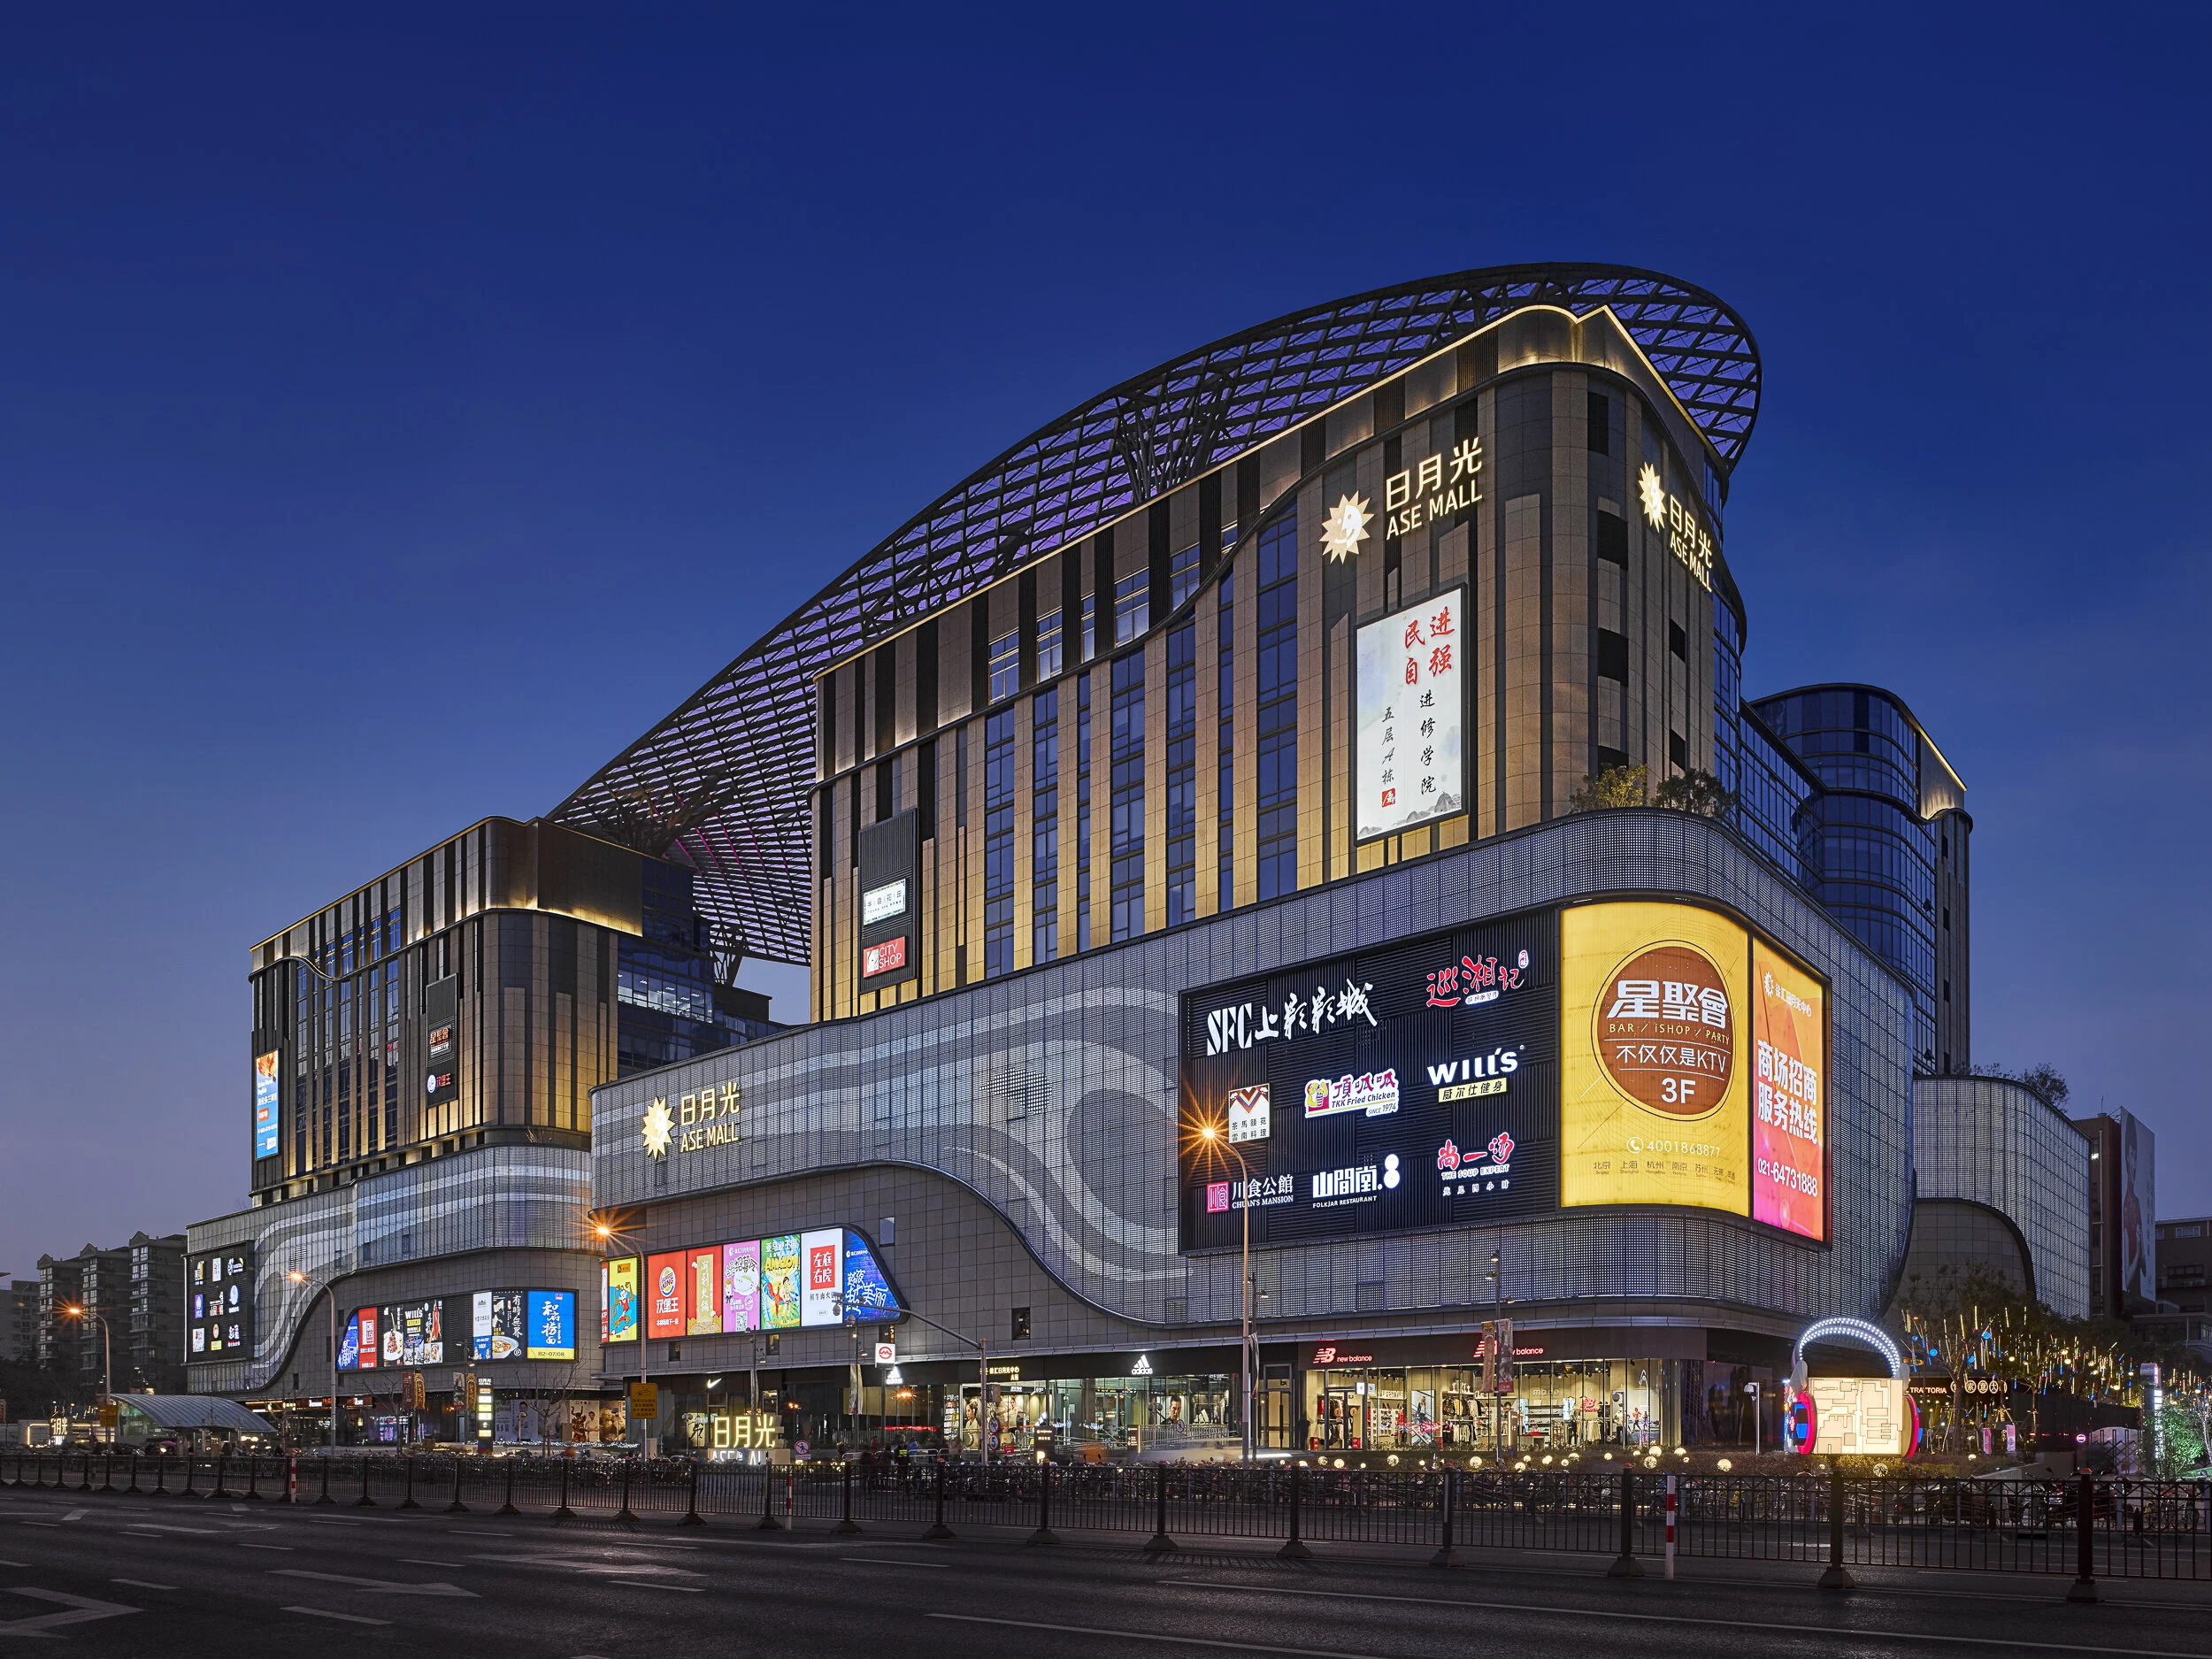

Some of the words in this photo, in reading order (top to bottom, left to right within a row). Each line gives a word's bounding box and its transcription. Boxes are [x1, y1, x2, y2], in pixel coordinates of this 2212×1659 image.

[1386, 436, 1482, 511] 日月光
[1386, 510, 1422, 541] ASE
[1429, 480, 1482, 522] MALL
[1670, 494, 1712, 569] 日月光
[1670, 532, 1688, 565] ASE
[1689, 551, 1712, 592] MALL
[1419, 689, 1437, 795] 进修学院
[879, 942, 899, 958] CITY
[879, 952, 902, 969] SHOP
[1606, 979, 1728, 1030] 星聚會
[1207, 1002, 1252, 1056] SFC
[1609, 1023, 1635, 1033] BAR
[1705, 1030, 1730, 1046] PARTY
[1616, 1043, 1726, 1074] 不仅仅是KTV
[1757, 1040, 1817, 1106] 商场招商
[1332, 1099, 1346, 1109] TKK
[1347, 1095, 1366, 1106] Fried
[1367, 1092, 1395, 1102] Chicken
[1442, 1080, 1503, 1101] 威尔仕健身
[1661, 1077, 1696, 1104] 3F
[680, 1081, 740, 1126] 日月光
[1368, 1107, 1381, 1116] SINCE
[1382, 1102, 1396, 1112] 1974
[1757, 1078, 1818, 1145] 服务热线
[680, 1128, 704, 1153] ASE
[706, 1121, 739, 1146] MALL
[1232, 1128, 1267, 1142] 雲南料理
[1647, 1140, 1721, 1158] 4001868877
[1441, 1171, 1457, 1180] THE
[1458, 1168, 1479, 1179] SOUP
[1479, 1164, 1509, 1175] EXPERT
[1593, 1161, 1611, 1170] 北京
[1620, 1160, 1638, 1169] 上海
[1232, 1173, 1294, 1201] 川食公館
[1757, 1159, 1818, 1198] 021-64731888
[1262, 1194, 1294, 1205] MANSION
[1312, 1200, 1339, 1209] FOLKJAR
[1339, 1195, 1378, 1205] RESTAURANT
[813, 1251, 832, 1268] 左庭
[813, 1267, 832, 1284] 右院
[656, 1296, 679, 1314] 汉堡王
[541, 1301, 561, 1345] 和府捞面
[1516, 1347, 1544, 1356] balance
[1380, 1389, 1405, 1400] LIFESTYLE
[714, 1414, 776, 1448] 日月光
[991, 1436, 997, 1448] 5
